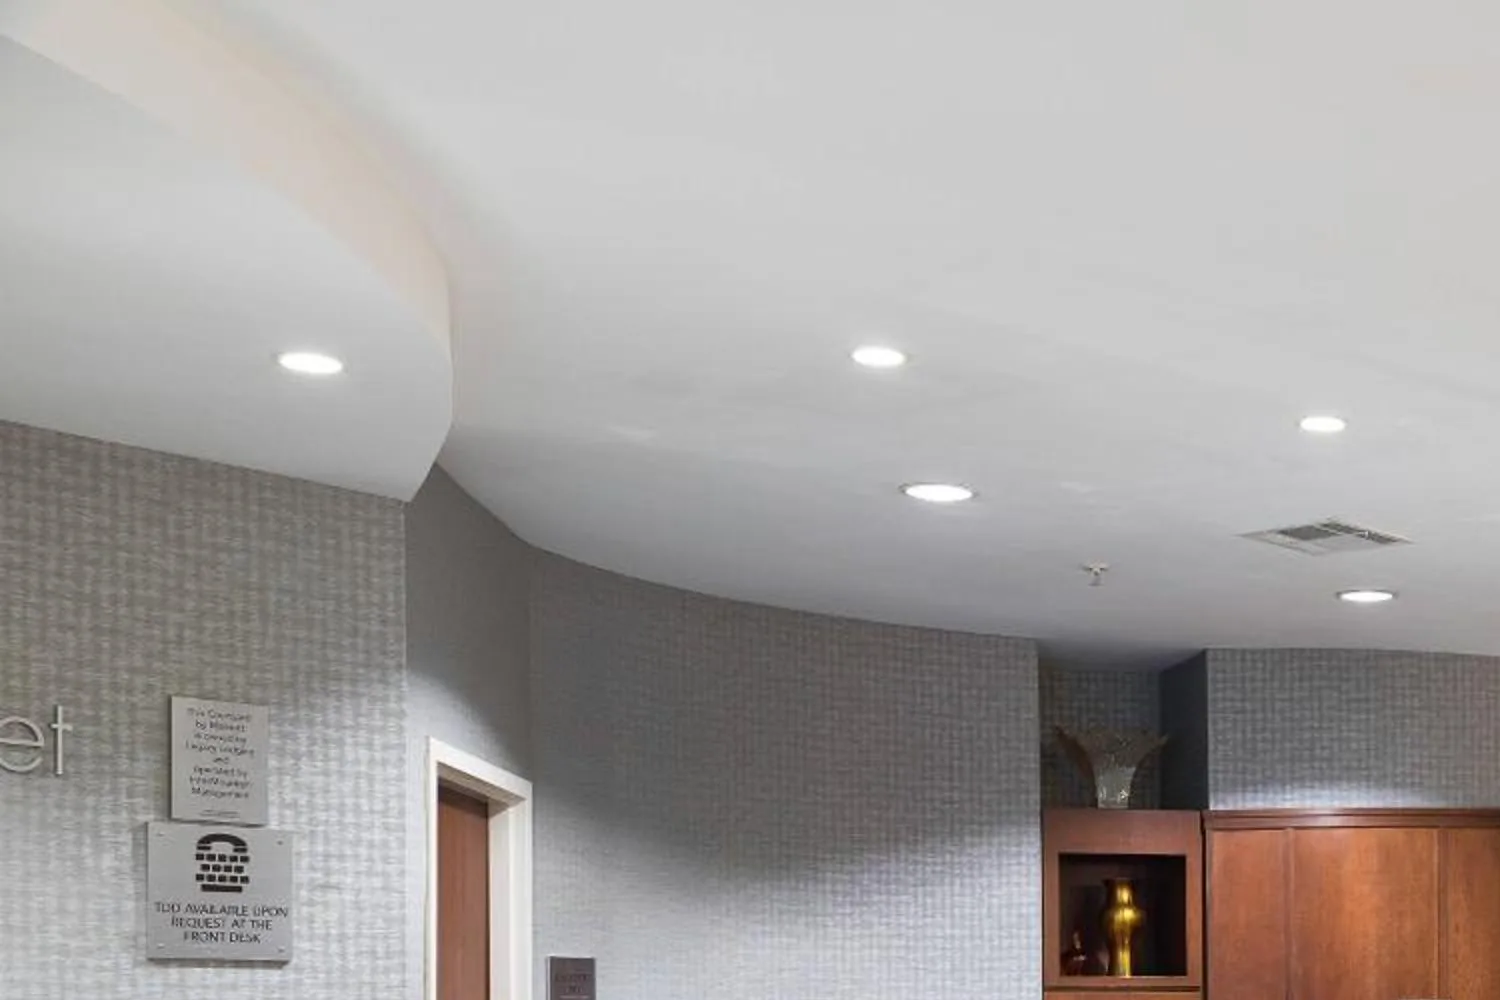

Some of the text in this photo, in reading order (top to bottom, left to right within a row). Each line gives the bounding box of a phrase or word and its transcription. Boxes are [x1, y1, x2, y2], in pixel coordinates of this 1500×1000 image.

[185, 903, 249, 917] AVAILABLE
[253, 905, 288, 918] UPON
[171, 916, 273, 931] REQUEST AT THE
[183, 930, 261, 944] FRONT DESK
